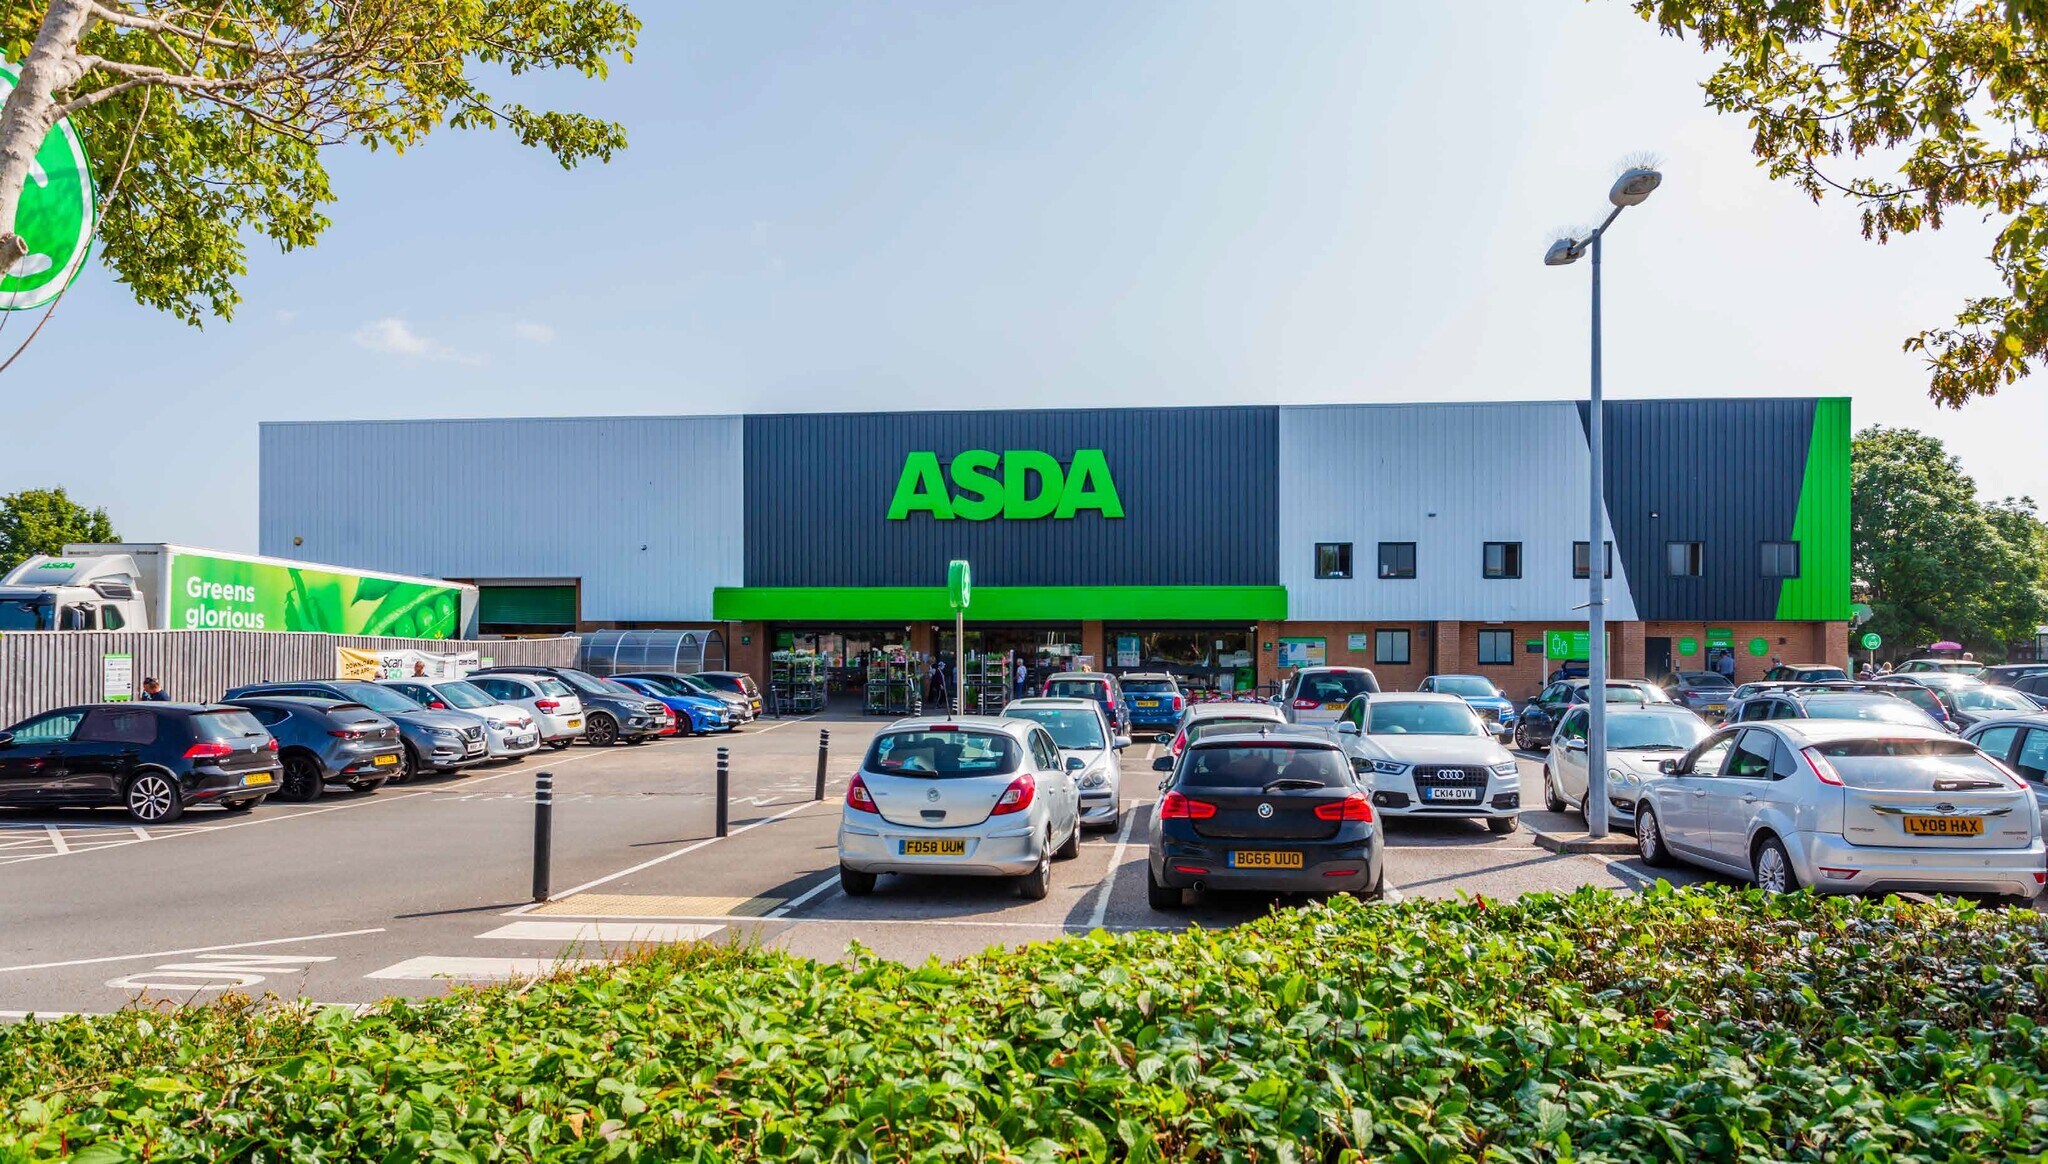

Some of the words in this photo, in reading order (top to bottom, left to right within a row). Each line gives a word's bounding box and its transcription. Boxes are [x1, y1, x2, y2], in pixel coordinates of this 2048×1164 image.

[886, 448, 1125, 521] ASDA
[186, 576, 255, 602] Greens
[185, 603, 265, 629] glorious
[381, 656, 403, 668] Scan
[389, 668, 403, 679] GO
[1434, 789, 1454, 798] CK14
[1909, 819, 1947, 832] LY08
[1950, 819, 1978, 833] HAX
[906, 841, 938, 853] FD58
[941, 840, 965, 853] UUM
[1237, 852, 1271, 865] BG66
